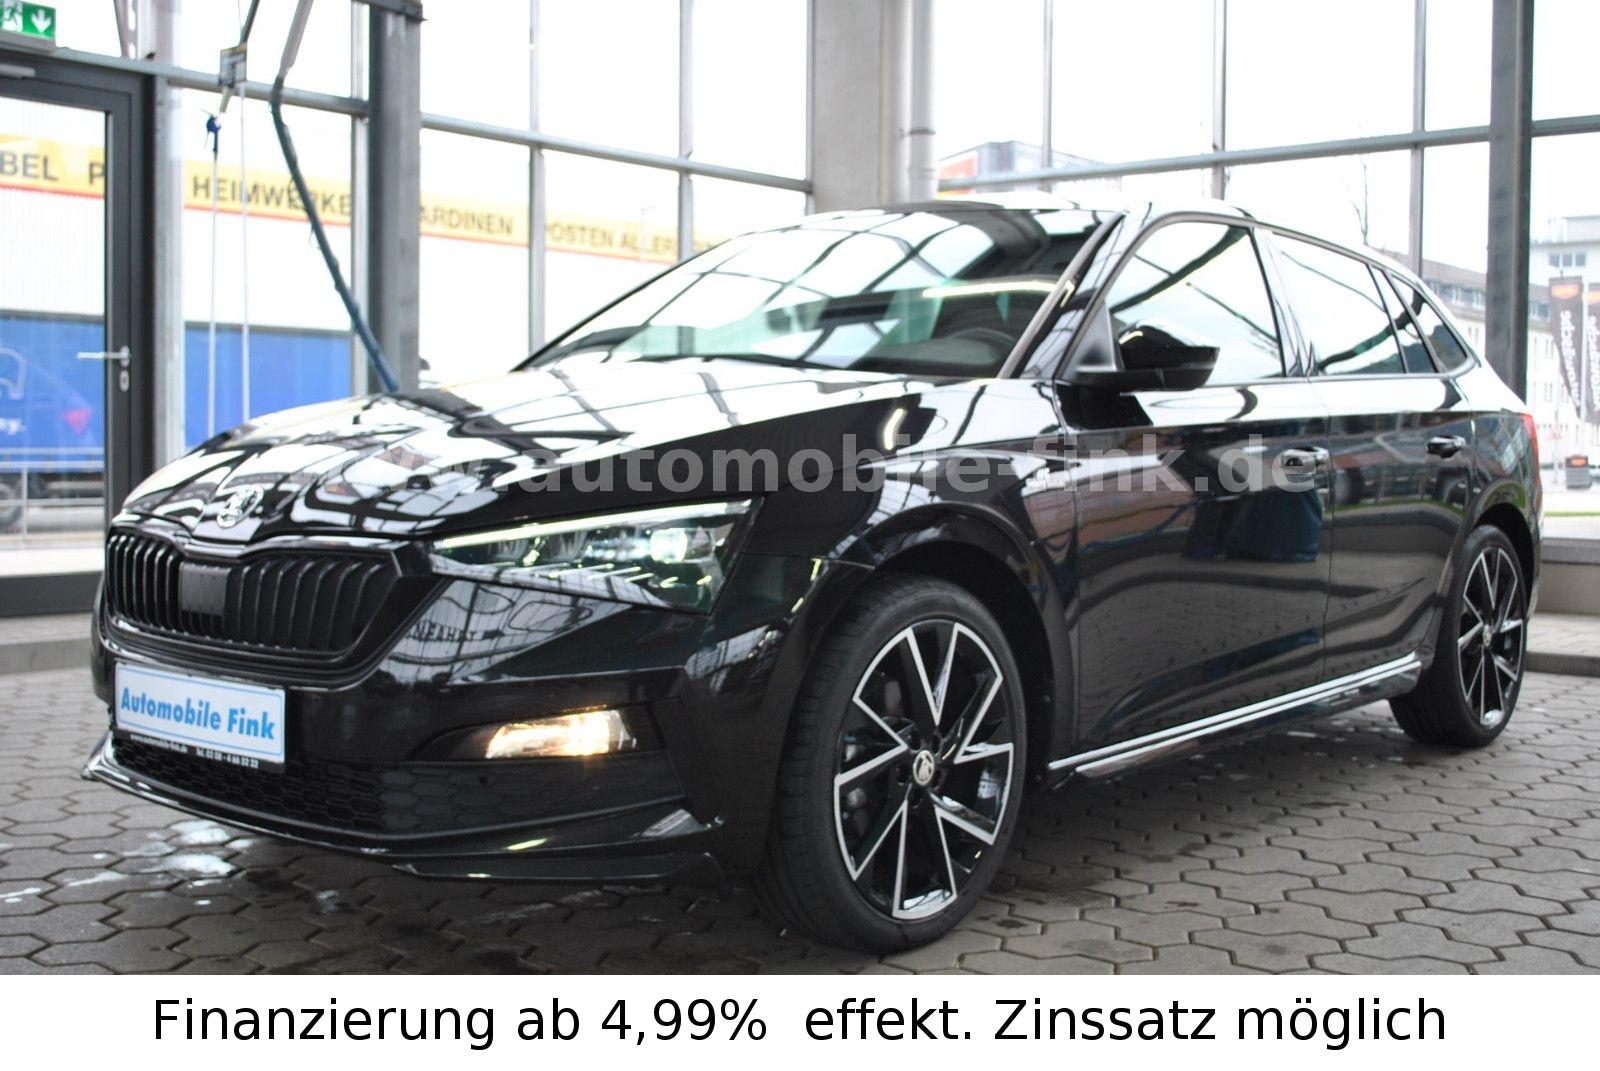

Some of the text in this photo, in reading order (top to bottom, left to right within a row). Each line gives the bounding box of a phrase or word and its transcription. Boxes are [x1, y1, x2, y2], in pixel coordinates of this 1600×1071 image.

[545, 222, 613, 248] OSTEN
[121, 687, 276, 740] Automobile Fink
